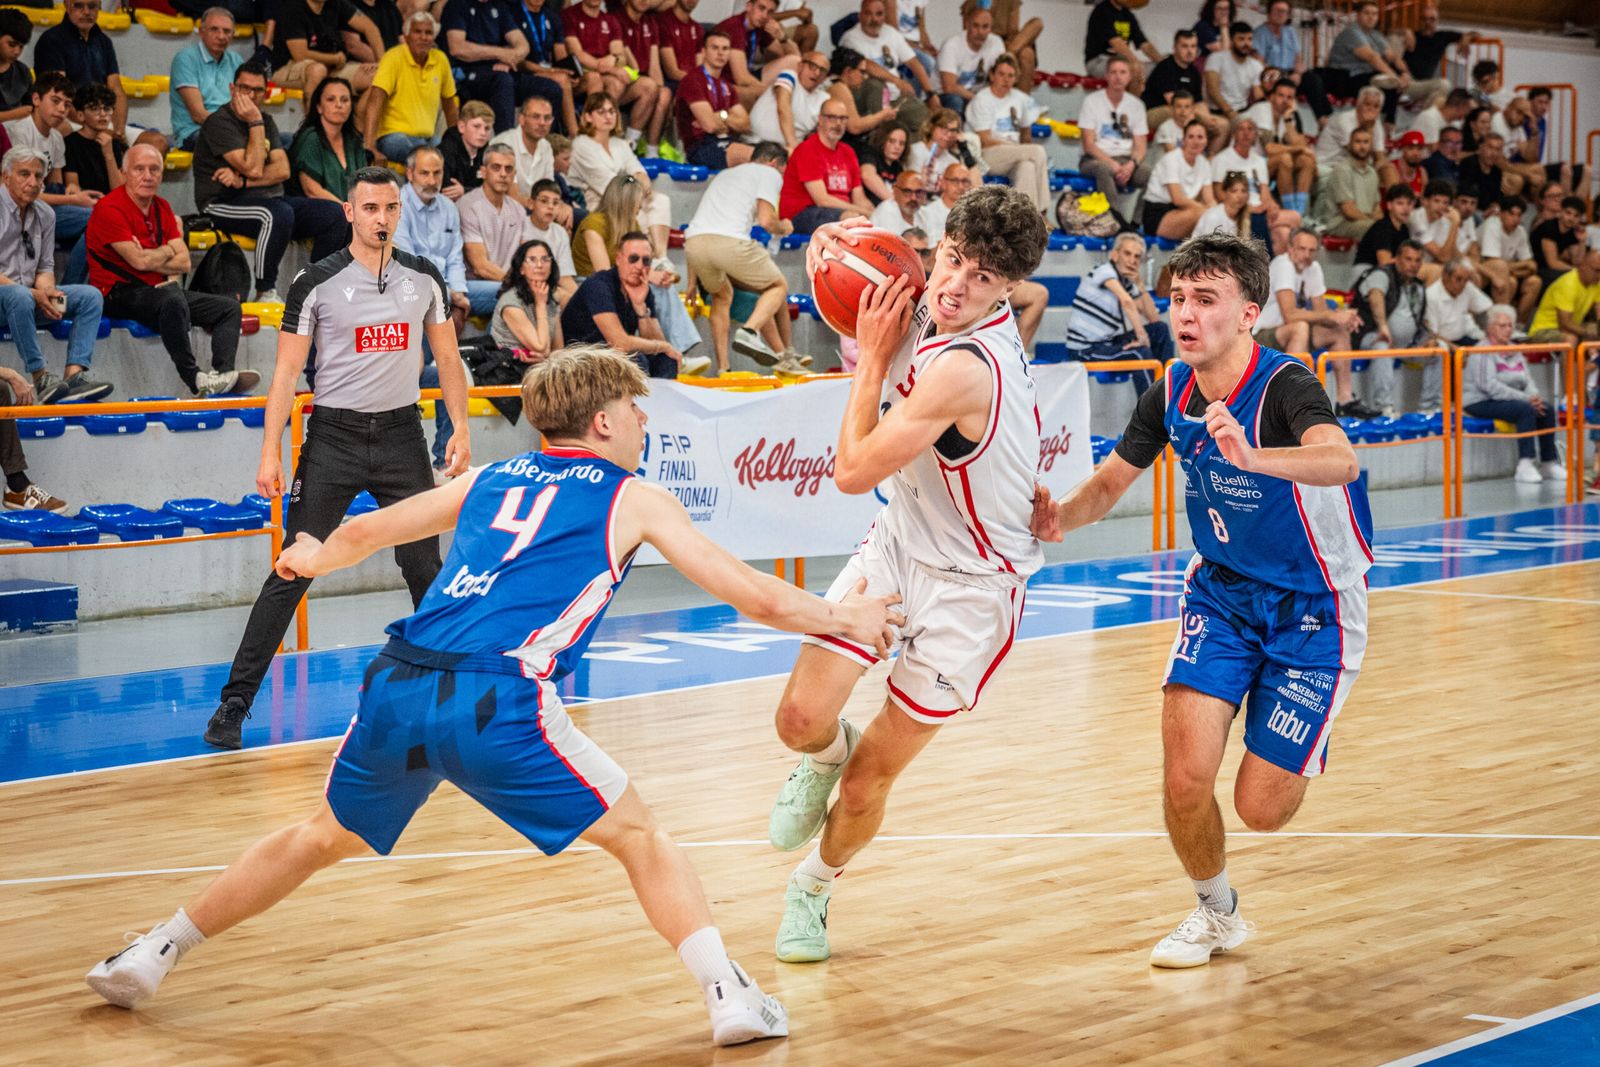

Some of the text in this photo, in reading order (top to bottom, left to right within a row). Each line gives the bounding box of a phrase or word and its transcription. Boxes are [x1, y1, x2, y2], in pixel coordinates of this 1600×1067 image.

[362, 324, 405, 339] ATTAL
[361, 337, 405, 348] GROUP
[659, 434, 692, 454] FIP
[658, 460, 696, 481] FINALI
[734, 437, 836, 497] Kellogg's
[1210, 470, 1249, 488] Buelli
[1212, 483, 1263, 499] Rasero
[489, 484, 560, 562] 4
[1208, 508, 1230, 544] 8
[1267, 701, 1311, 745] tabu
